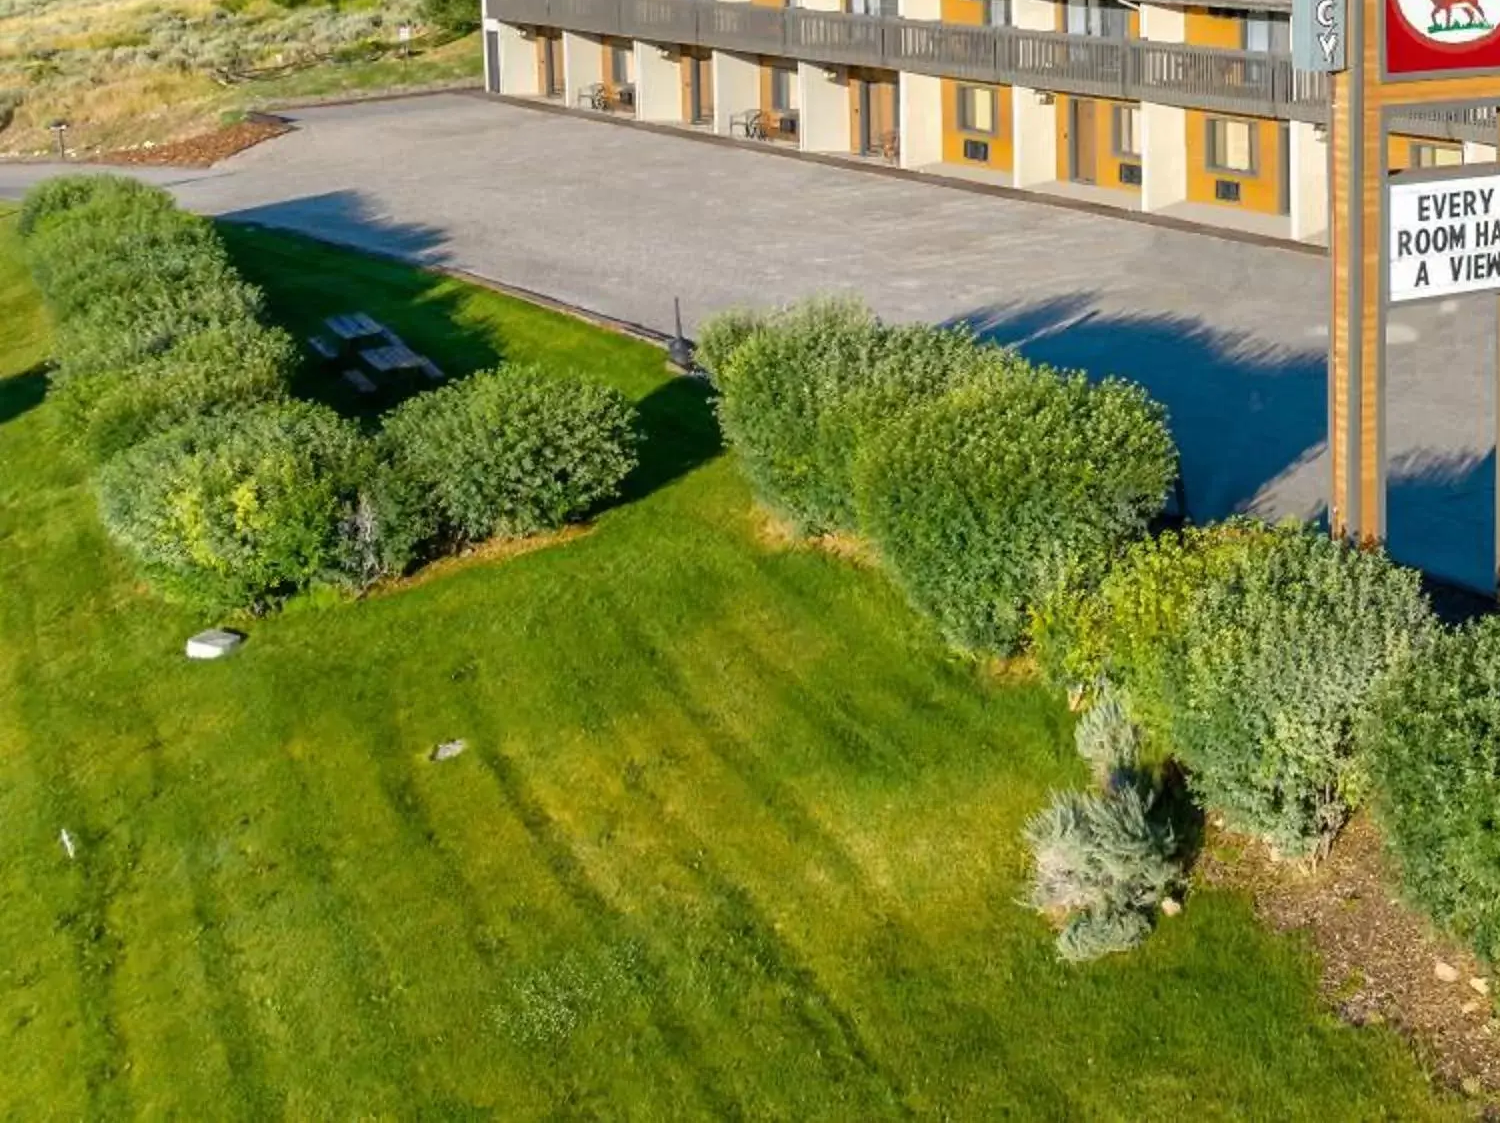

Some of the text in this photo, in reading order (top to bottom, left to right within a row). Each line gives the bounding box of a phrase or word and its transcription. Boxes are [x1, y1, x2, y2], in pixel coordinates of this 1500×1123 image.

[1417, 188, 1494, 221] EVERY
[1397, 223, 1466, 257] ROOM
[1414, 260, 1430, 287] A
